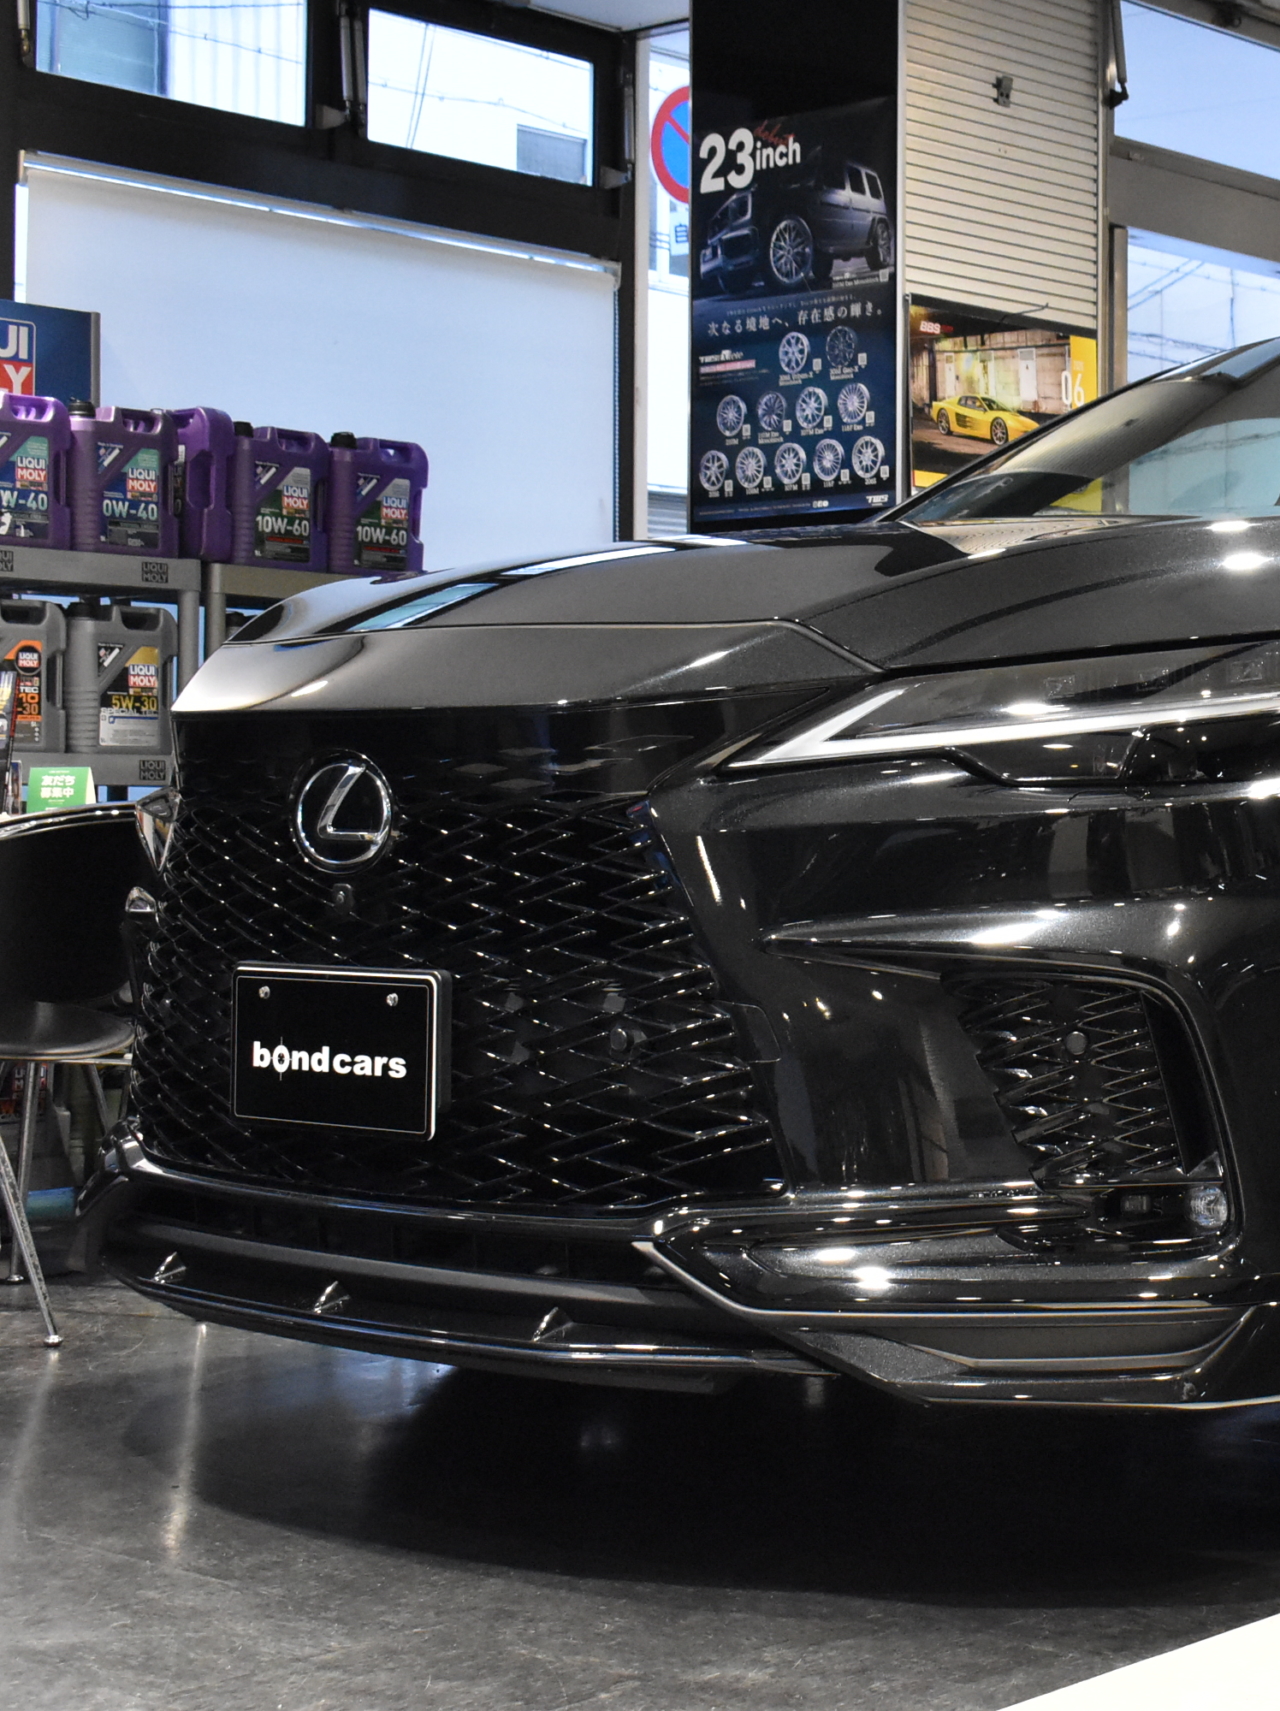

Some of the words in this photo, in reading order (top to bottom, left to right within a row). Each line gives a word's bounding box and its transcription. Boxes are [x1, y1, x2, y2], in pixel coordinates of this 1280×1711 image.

[919, 320, 942, 334] BBS
[1061, 370, 1085, 407] 06
[17, 456, 46, 469] LIQUI
[17, 468, 47, 481] MOLY
[128, 467, 156, 480] LIQUI
[128, 479, 157, 492] MOLY
[283, 485, 309, 498] LIQUI
[284, 497, 310, 508] MOLY
[382, 497, 408, 509] LIQUI
[102, 499, 158, 521] 0W-40
[383, 507, 408, 519] MOLY
[255, 515, 310, 537] 10W-60
[356, 525, 408, 547] 10W-60
[142, 562, 168, 573] LIQUI
[142, 572, 168, 584] MOLY
[19, 652, 39, 660] LIQUI
[18, 659, 40, 667] MOLY
[130, 664, 156, 676] LIQUI
[130, 675, 157, 687] MOLY
[111, 695, 158, 711] 5W-30
[140, 760, 166, 771] LIQUI
[41, 774, 76, 786] 友だち
[140, 770, 166, 780] MOLY
[252, 1040, 407, 1079] bondcars
